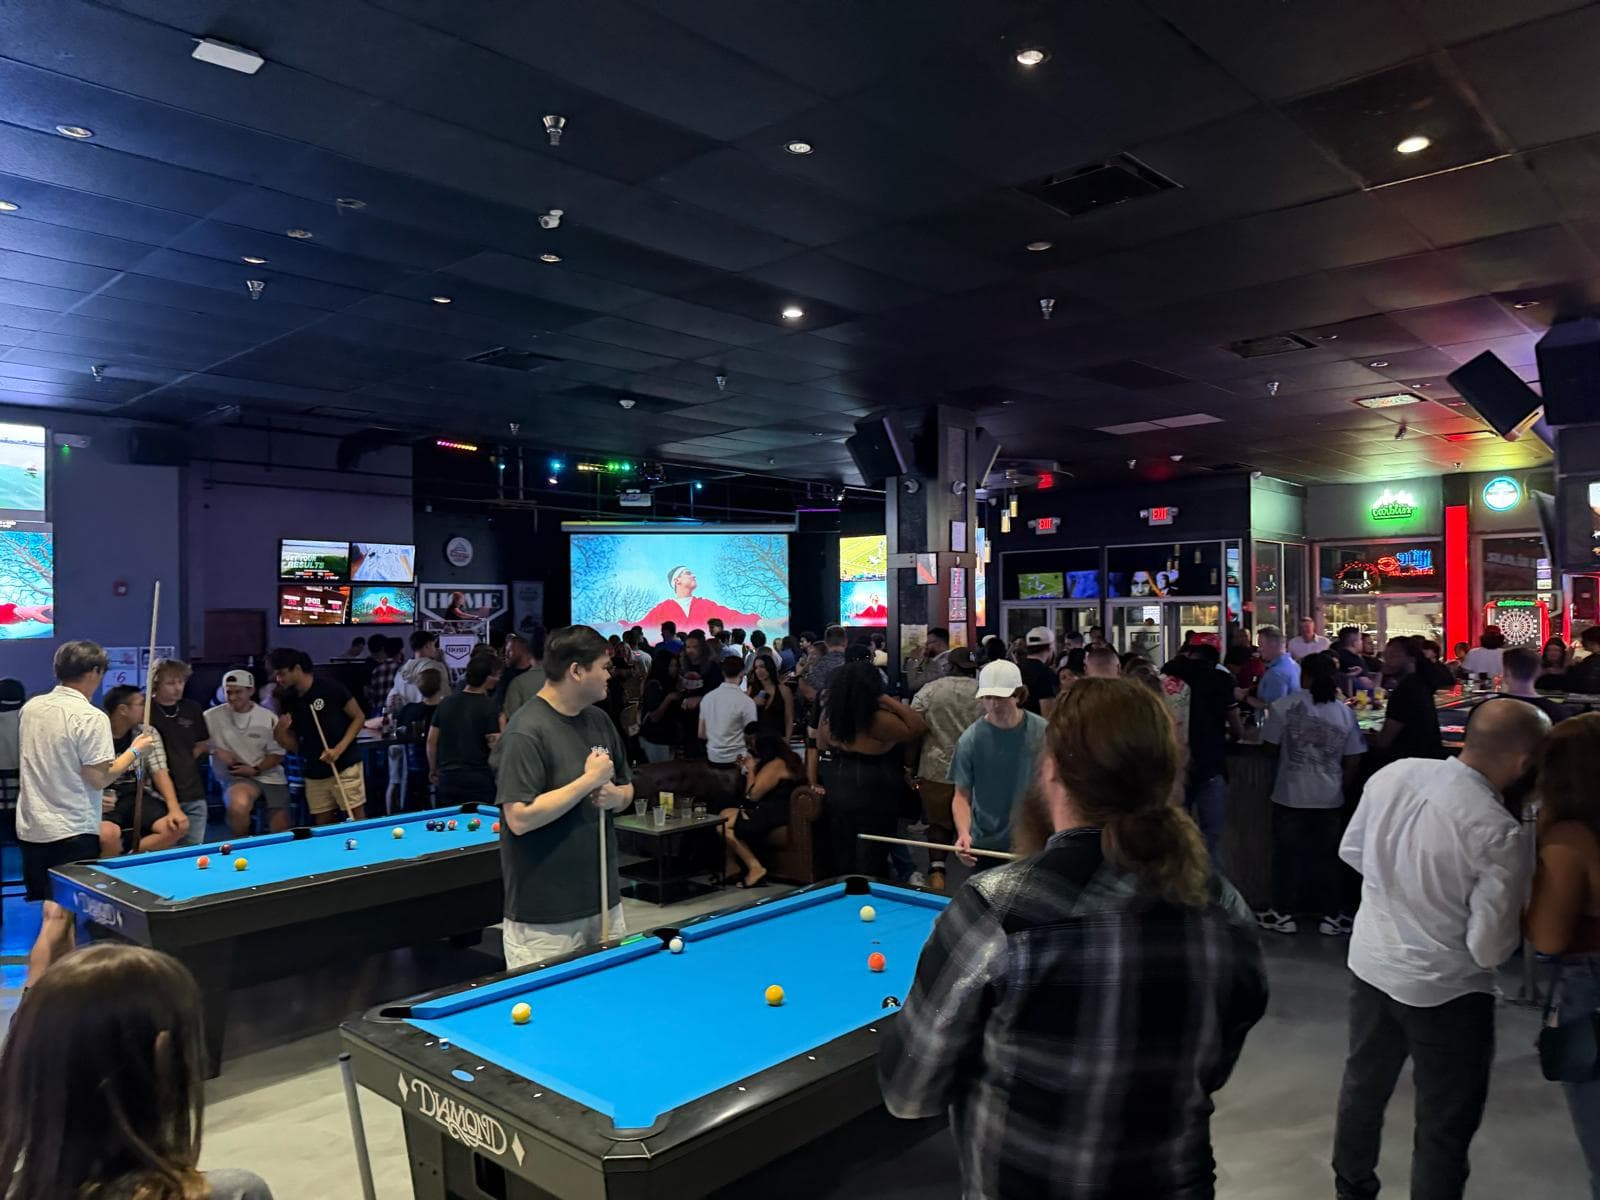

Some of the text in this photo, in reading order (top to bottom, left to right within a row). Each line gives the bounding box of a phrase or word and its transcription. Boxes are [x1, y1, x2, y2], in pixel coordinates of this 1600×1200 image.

[1152, 508, 1168, 520] EXIT
[1039, 518, 1053, 530] EXIT
[411, 1078, 508, 1155] DIAMOND
